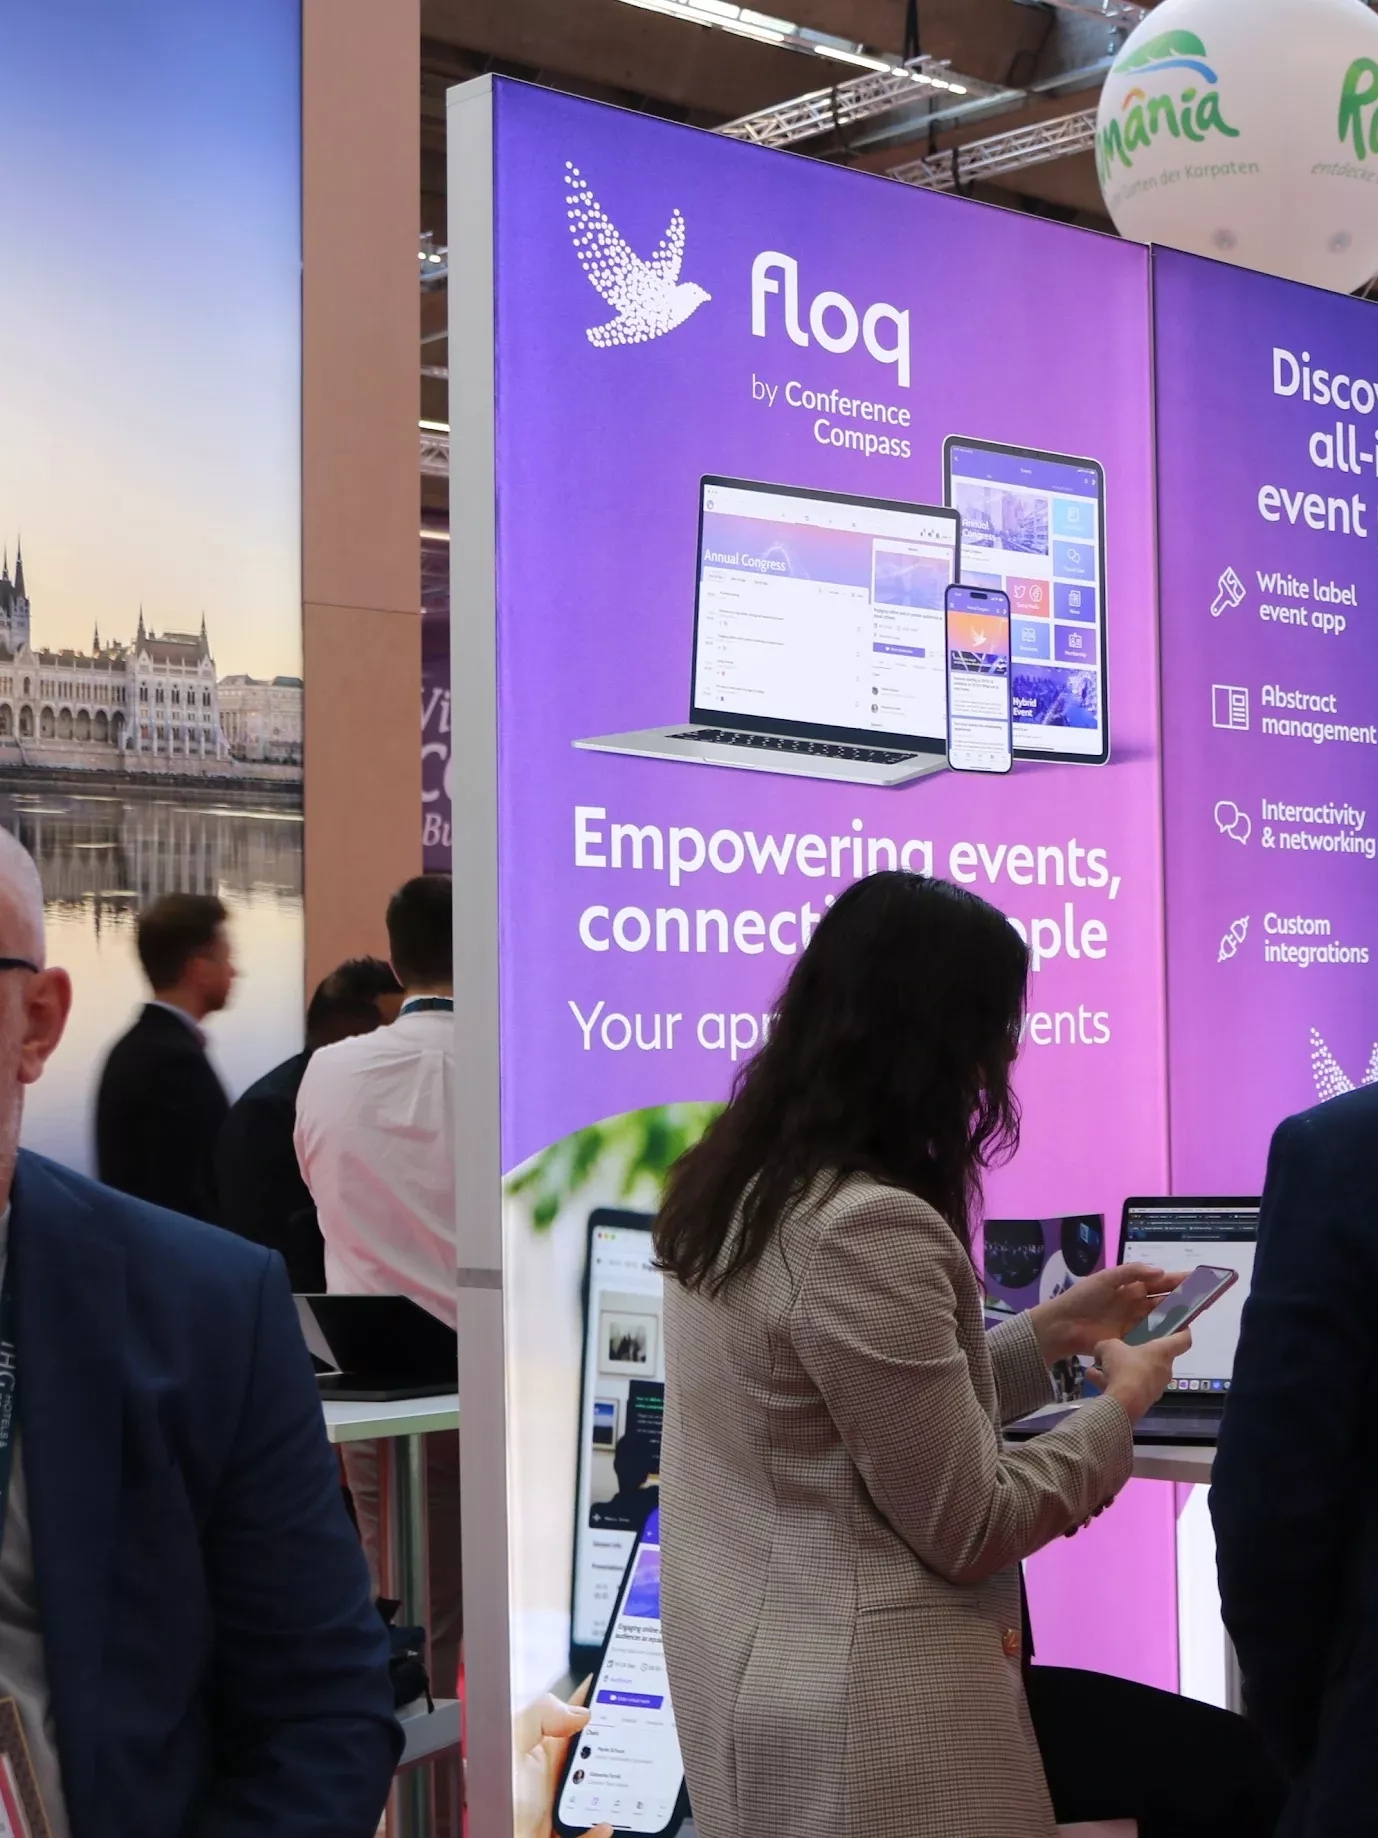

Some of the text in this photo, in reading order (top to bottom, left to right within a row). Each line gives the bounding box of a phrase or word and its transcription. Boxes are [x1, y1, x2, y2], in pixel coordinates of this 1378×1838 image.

[1160, 168, 1180, 186] der
[1185, 160, 1260, 181] Karpaten
[751, 250, 911, 388] floq
[751, 373, 911, 428] by Conference
[813, 419, 911, 460] Compass
[1257, 483, 1368, 539] event
[703, 549, 787, 573] Annual Congress
[1256, 570, 1358, 607] White label
[1259, 604, 1346, 636] event app
[1261, 684, 1338, 714] Abstract
[1262, 717, 1378, 746] management
[1261, 799, 1367, 832] Interactivity
[573, 804, 1122, 900] Empowering events,
[1261, 826, 1377, 860] & networking
[578, 894, 838, 956] connect
[1263, 912, 1331, 936] Custom
[1264, 940, 1370, 969] integrations
[568, 1000, 683, 1052] Your
